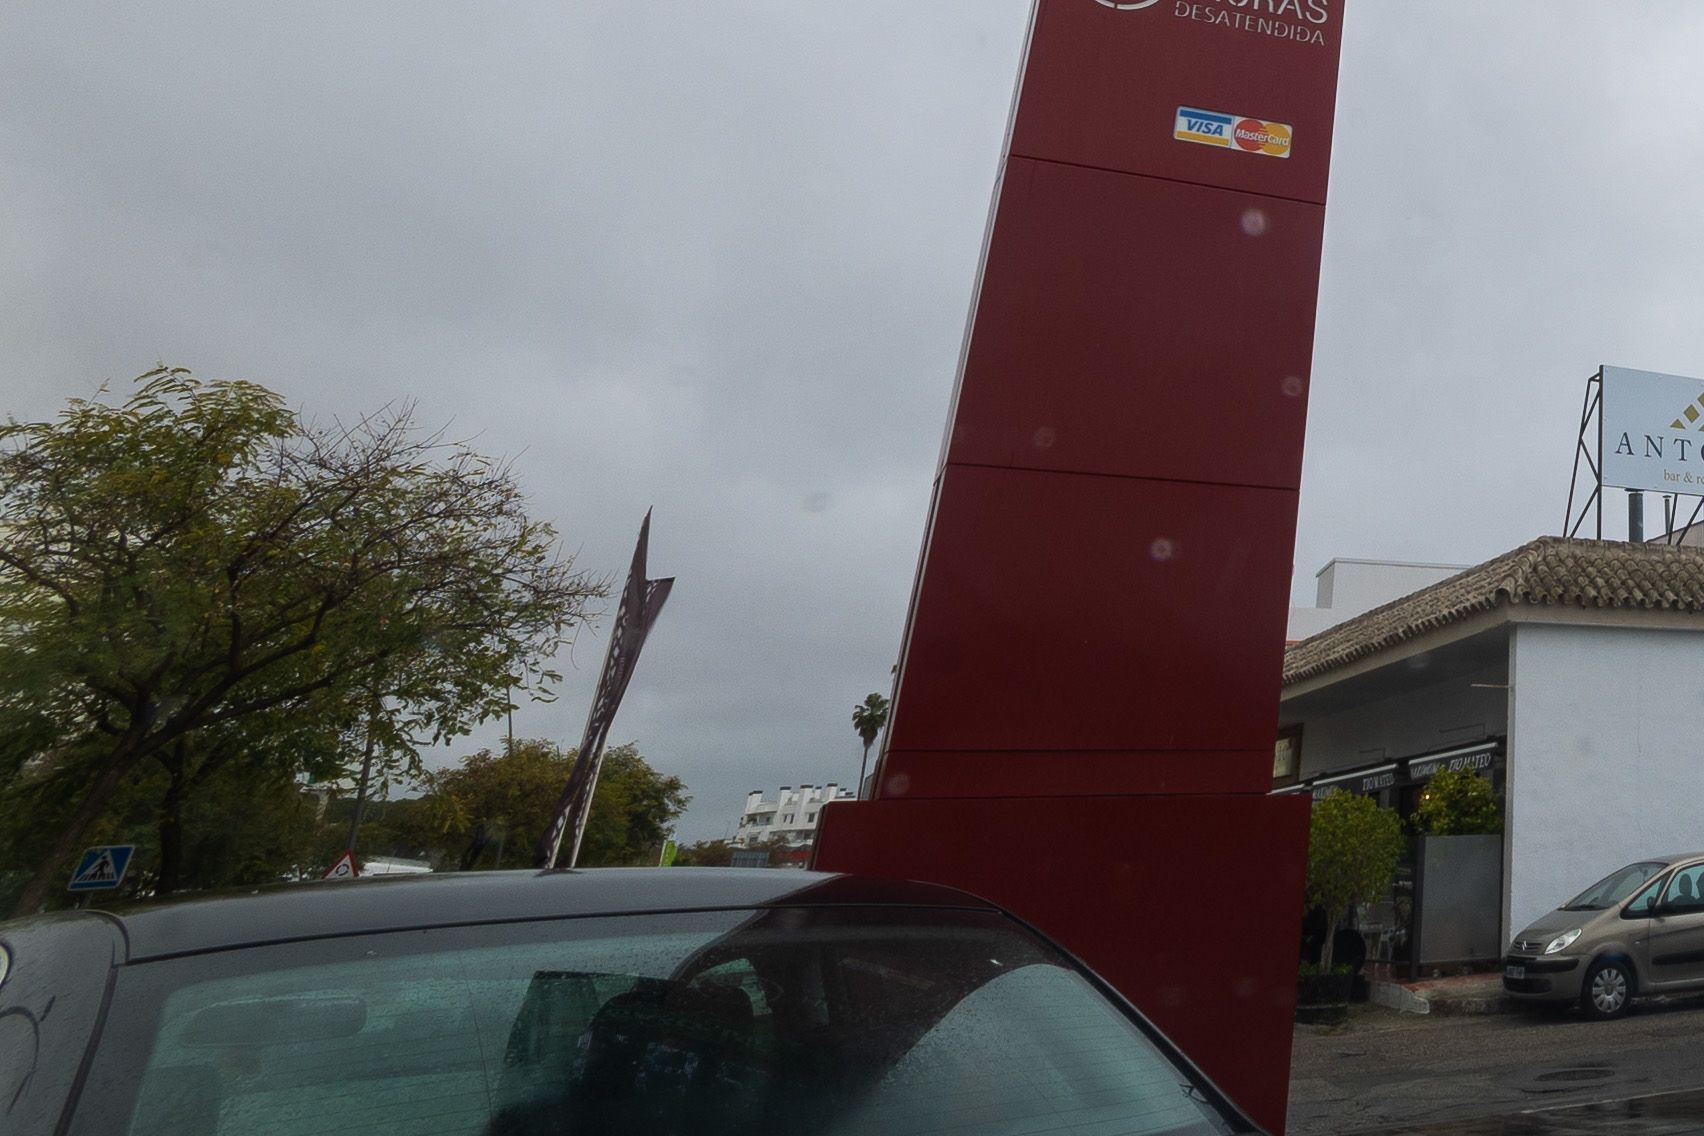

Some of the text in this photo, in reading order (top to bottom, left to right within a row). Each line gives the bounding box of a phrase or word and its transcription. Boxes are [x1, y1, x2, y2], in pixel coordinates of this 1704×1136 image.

[1174, 0, 1326, 46] DESATENDIDA
[1185, 118, 1225, 136] VISA
[1234, 127, 1290, 147] MasterCard
[1663, 469, 1681, 481] bar
[1683, 471, 1693, 483] &
